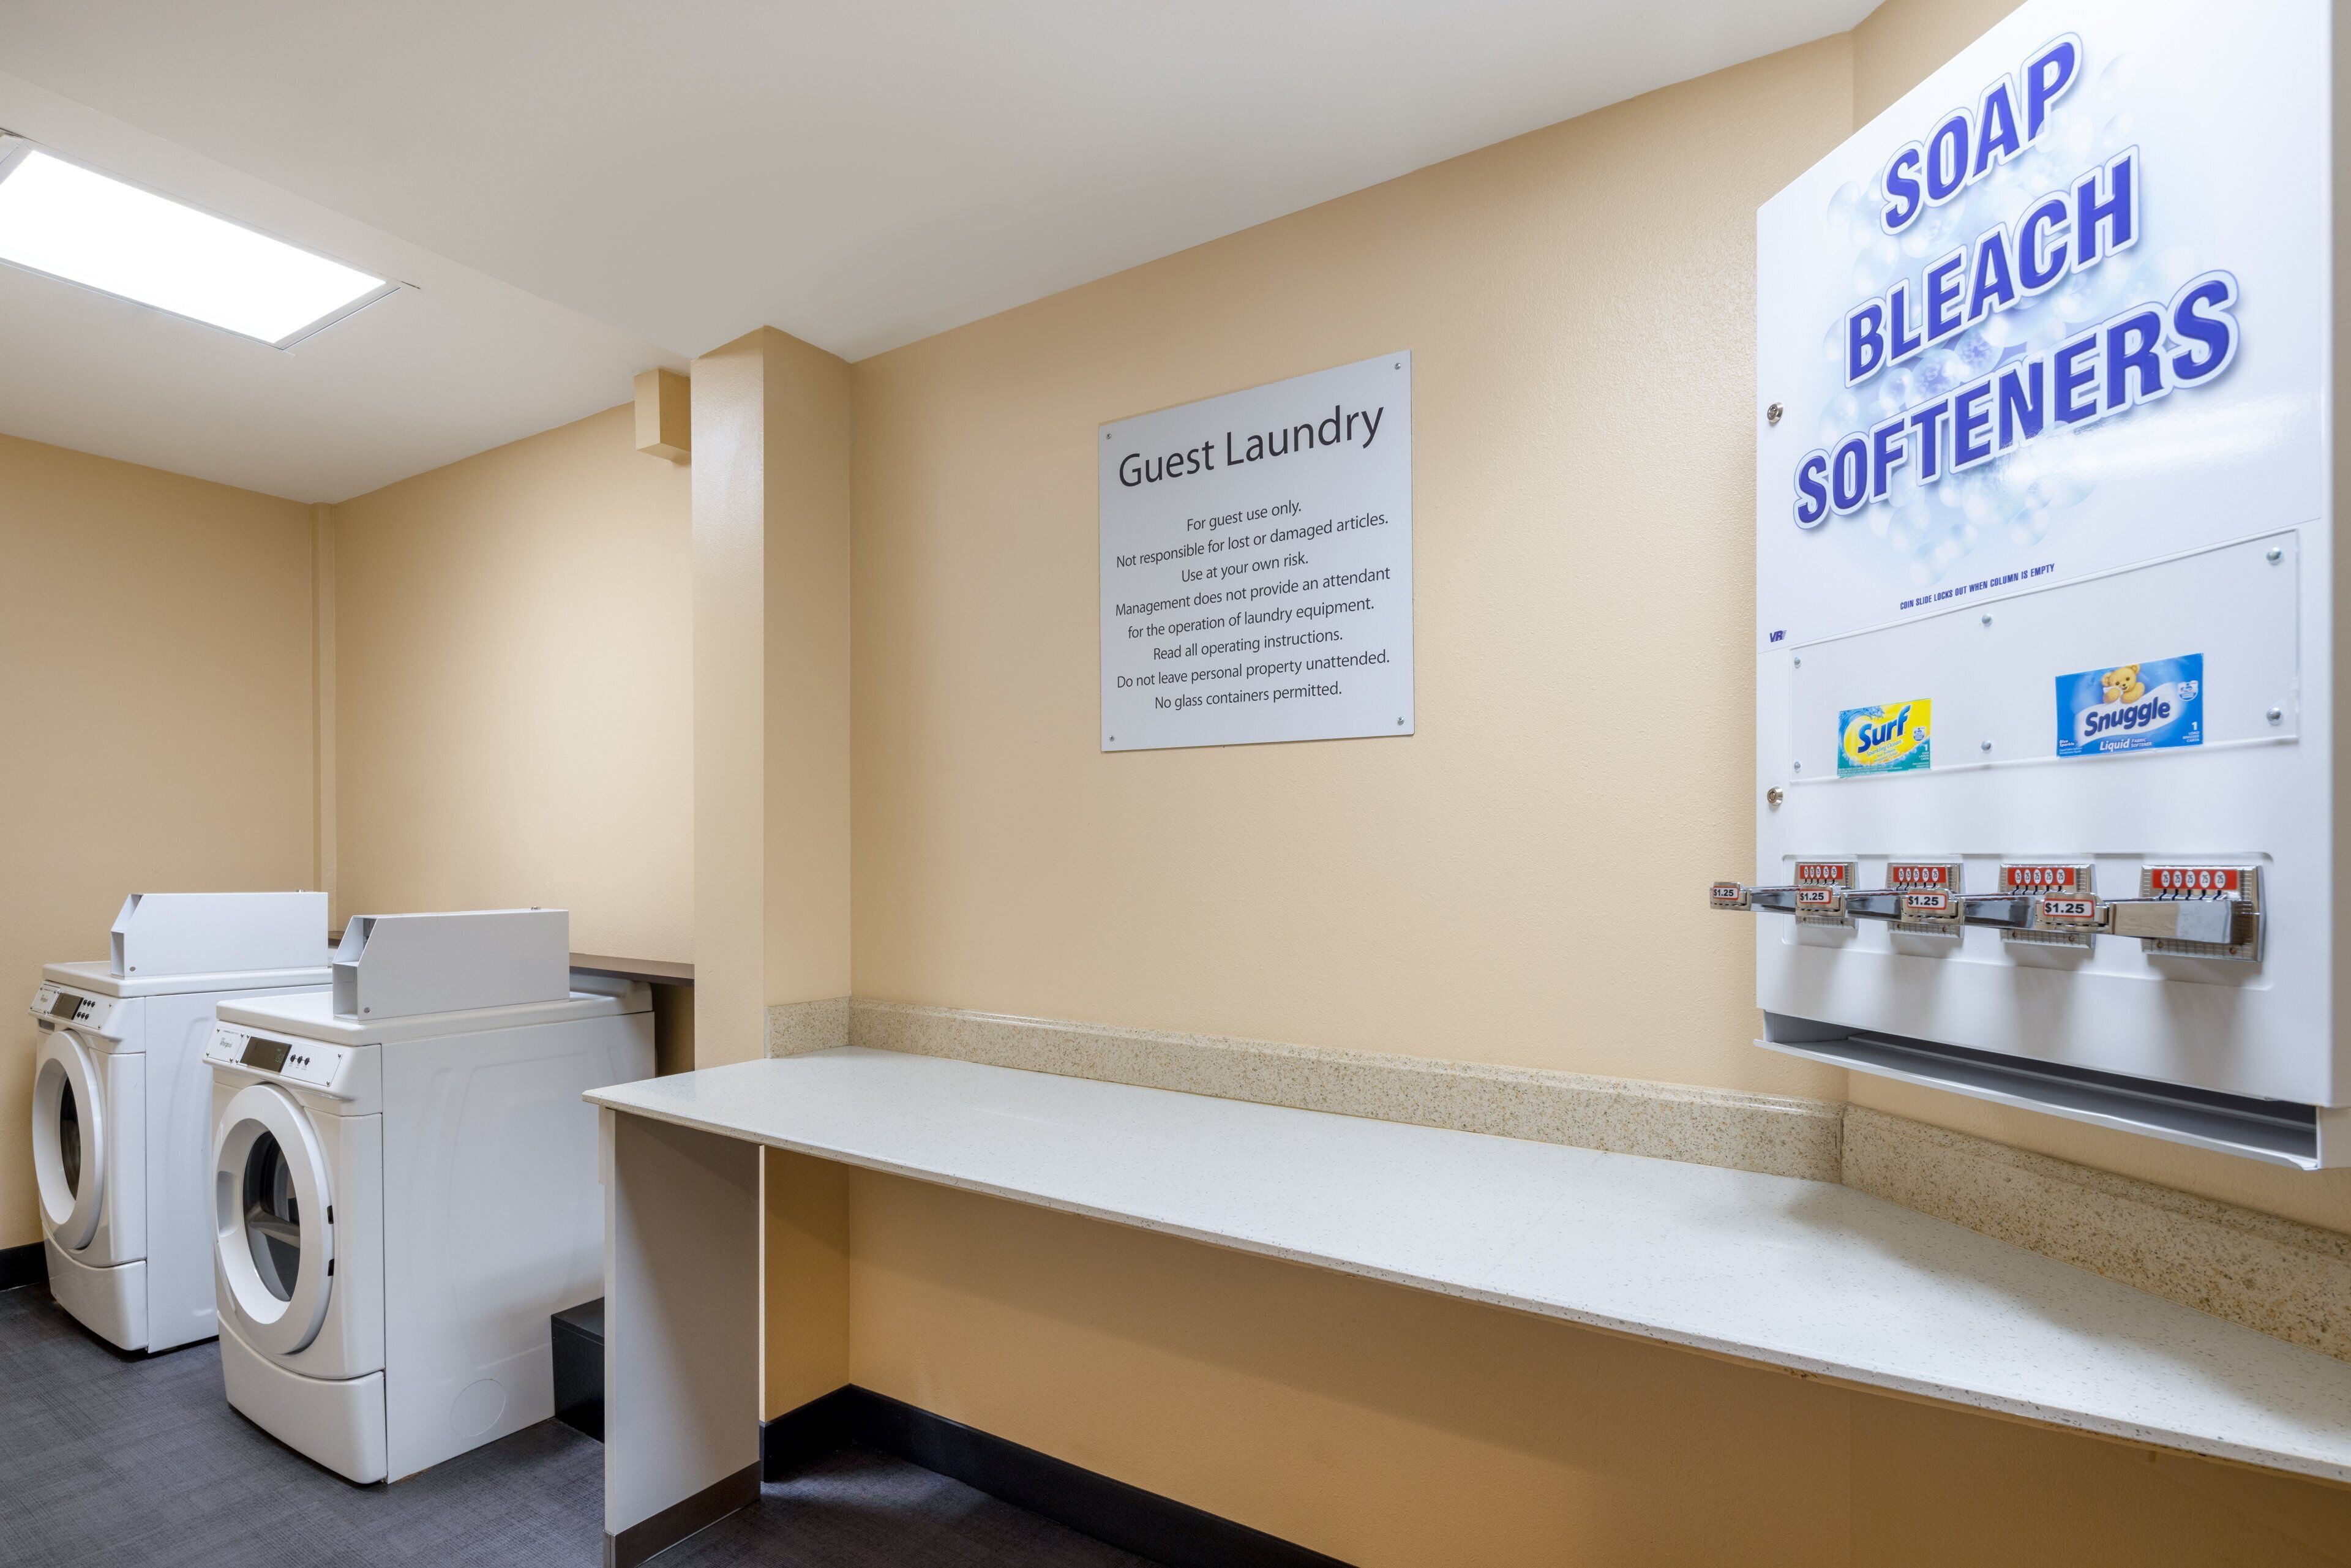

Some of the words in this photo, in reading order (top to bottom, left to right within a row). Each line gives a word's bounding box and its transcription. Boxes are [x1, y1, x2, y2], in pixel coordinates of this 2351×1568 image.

[1885, 42, 2075, 228] SOAP
[1849, 156, 2132, 381] BLEACH
[1798, 279, 2230, 523] SOFTENERS
[1119, 440, 1215, 487] Guest
[1226, 404, 1384, 467] Laundry
[1187, 518, 1206, 532] For
[1209, 511, 1243, 531] guest
[1247, 508, 1268, 521] use
[1271, 499, 1302, 517] only.
[1117, 555, 1137, 568] Not
[1139, 542, 1205, 565] responsible
[1207, 539, 1225, 553] for
[1228, 535, 1250, 550] lost
[1253, 534, 1267, 546] or
[1270, 519, 1332, 543] damaged
[1337, 512, 1389, 532] articles.
[1182, 569, 1203, 582] Use
[1205, 566, 1218, 579] at
[1220, 563, 1249, 580] your
[1251, 558, 1280, 572] own
[1284, 550, 1308, 568] risk.
[1116, 595, 1191, 617] Management
[1193, 591, 1223, 606] does
[1226, 587, 1247, 602] not
[1250, 579, 1299, 602] provide
[1302, 579, 1319, 591] an
[1322, 567, 1391, 588] attendant
[1900, 599, 1914, 610] COIN
[1916, 595, 1932, 606] SLIDE
[1933, 589, 1953, 602] LOCKS
[1955, 585, 1968, 596] OUT
[1969, 581, 1988, 593] WHEN
[1990, 572, 2019, 587] COLUMN
[2021, 570, 2028, 580] IS
[2030, 563, 2055, 577] EMPTY
[1127, 625, 1144, 639] for
[1146, 623, 1165, 637] the
[1168, 617, 1225, 637] operation
[1228, 612, 1242, 626] of
[1245, 607, 1293, 625] laundry
[1296, 597, 1374, 620] equipment.
[1153, 644, 1182, 661] Read
[1185, 642, 1198, 657] all
[1201, 638, 1260, 658] operating
[1264, 629, 1343, 648] instructions.
[1769, 630, 1787, 642] VR
[1117, 675, 1133, 688] Do
[1136, 673, 1155, 686] not
[1158, 671, 1188, 685] leave
[1191, 663, 1242, 685] personal
[1246, 660, 1302, 680] property
[1306, 648, 1390, 670] unattended.
[1155, 696, 1172, 710] No
[1174, 694, 1203, 711] glass
[1205, 689, 1269, 705] containers
[1273, 680, 1342, 703] permitted.
[1857, 704, 1911, 754] Surf
[2083, 696, 2171, 737] Snuggle
[2191, 721, 2198, 730] 1
[2099, 738, 2131, 752] Liquid
[1714, 888, 1734, 897] $1.25
[2163, 874, 2169, 883] 25
[2175, 874, 2180, 883] 25
[2187, 874, 2193, 883] 25
[2202, 874, 2208, 883] 25
[2217, 874, 2224, 883] 25
[1799, 891, 1824, 902] $1.25
[1907, 895, 1940, 907] $1.25
[2044, 902, 2085, 914] $1.25
